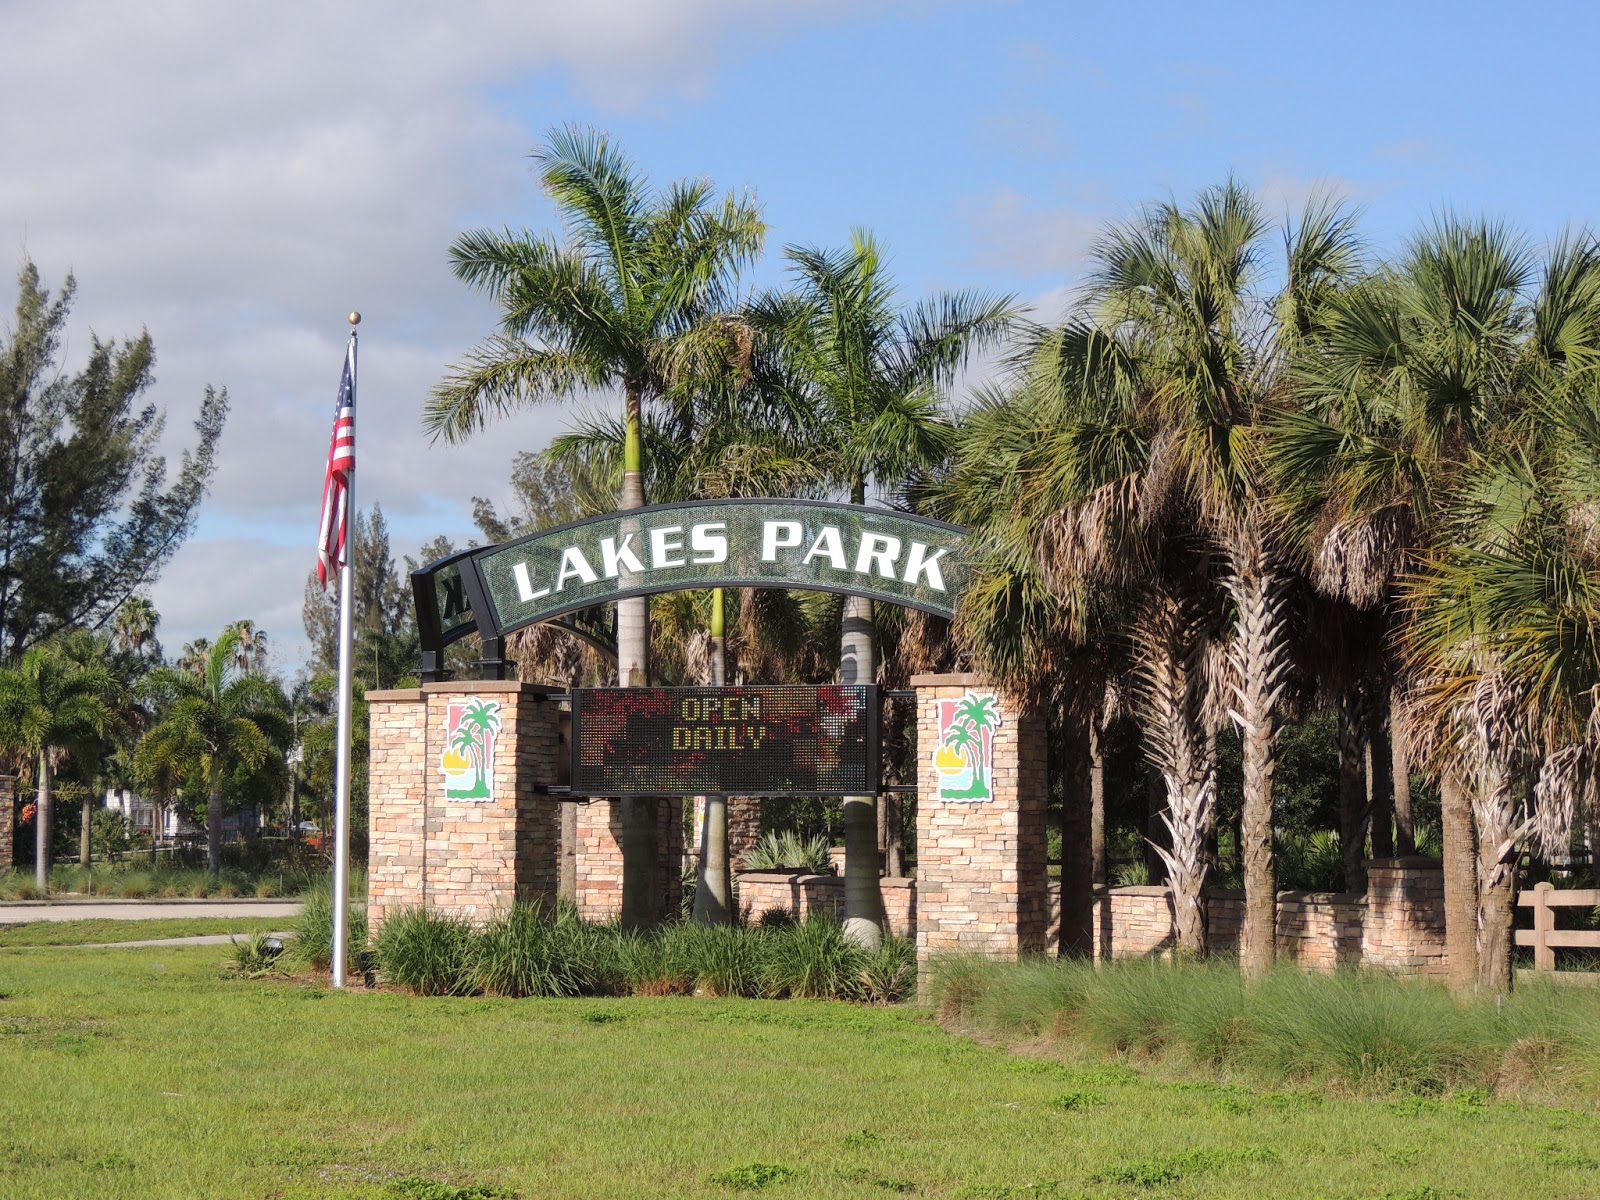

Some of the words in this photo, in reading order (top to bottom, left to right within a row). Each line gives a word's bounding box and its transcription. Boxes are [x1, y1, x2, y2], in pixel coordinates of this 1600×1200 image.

[512, 522, 727, 602] LAKES
[762, 521, 949, 592] PARK
[681, 697, 760, 721] OPEN
[673, 726, 766, 750] DAILY
